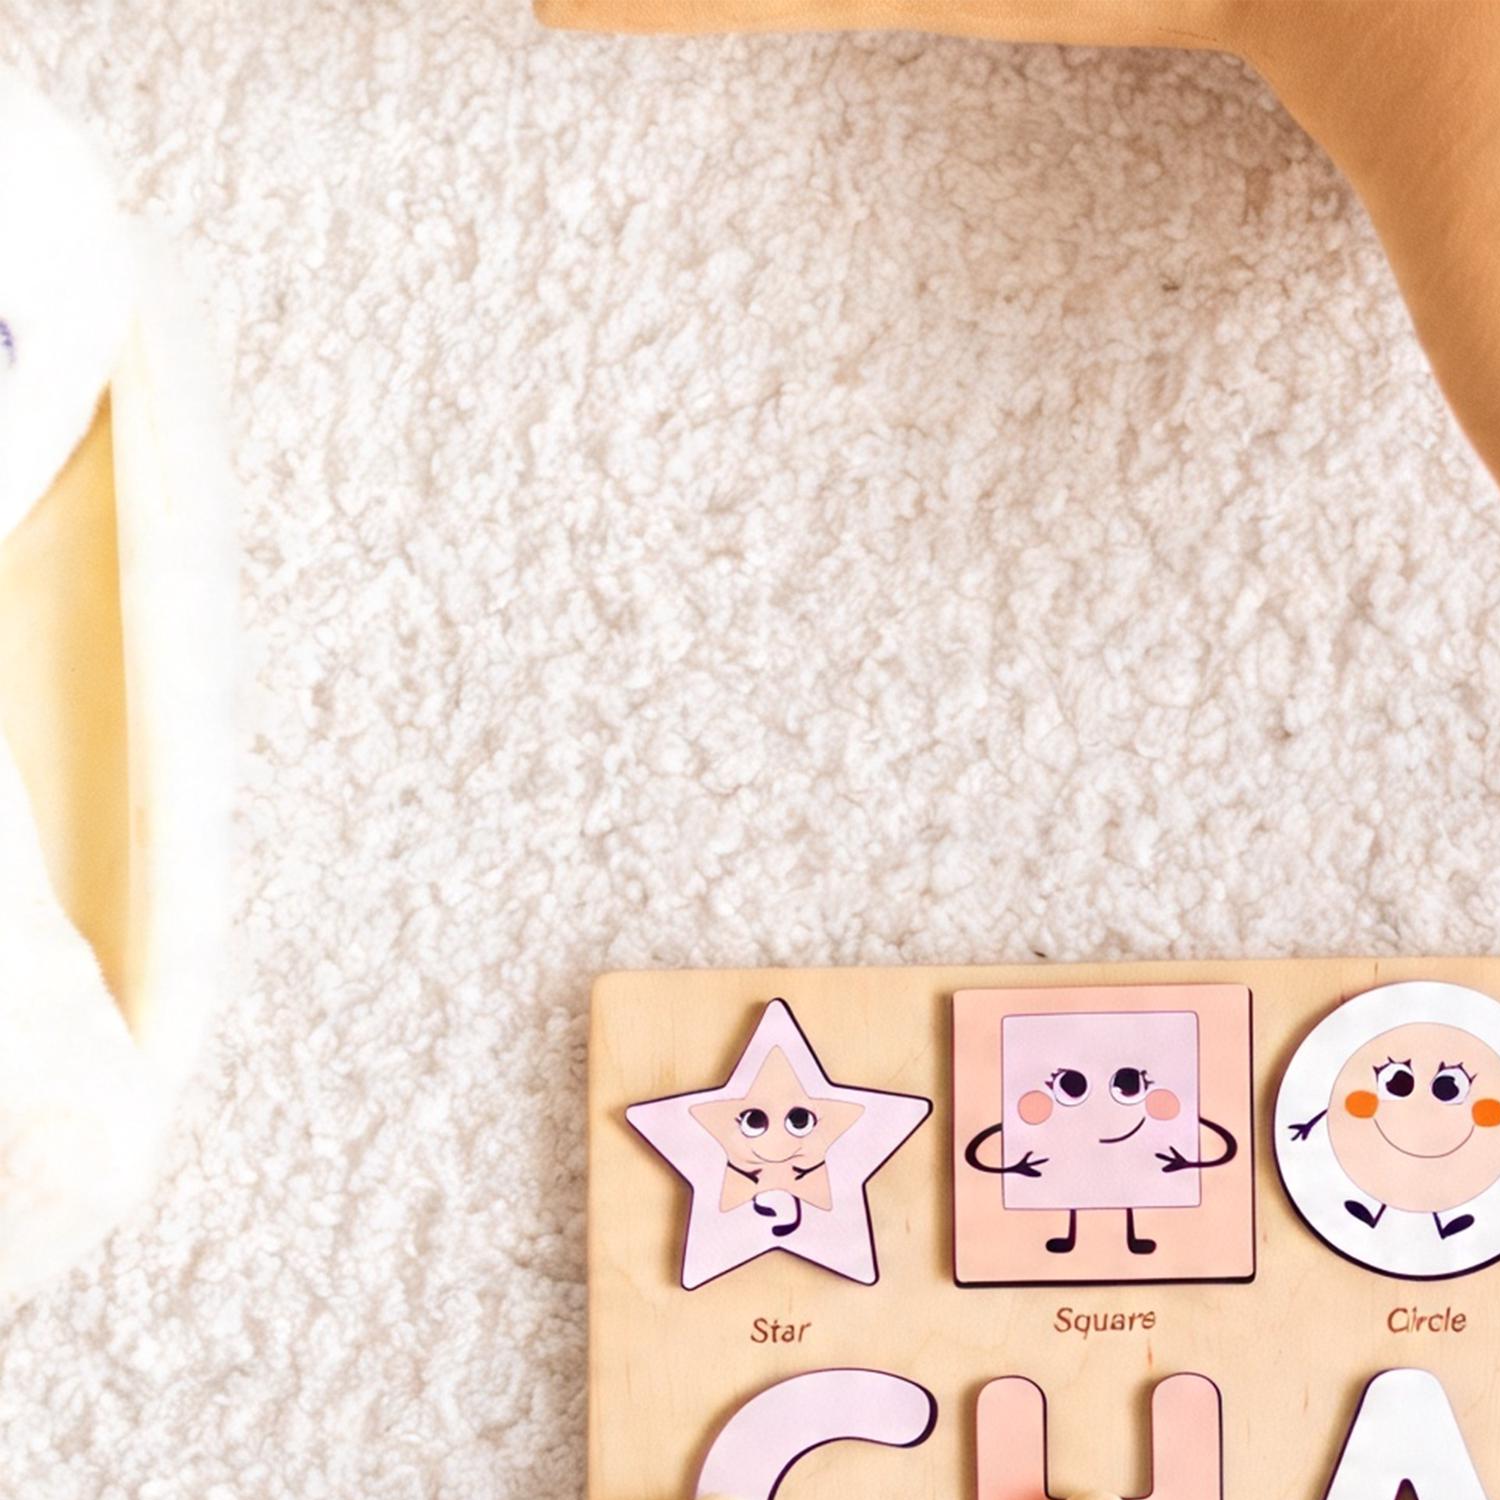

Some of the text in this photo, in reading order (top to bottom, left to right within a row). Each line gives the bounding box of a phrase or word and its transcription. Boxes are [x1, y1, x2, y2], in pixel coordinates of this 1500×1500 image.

[750, 1317, 811, 1344] Star
[1053, 1307, 1157, 1340] Square
[1387, 1306, 1467, 1333] Circle
